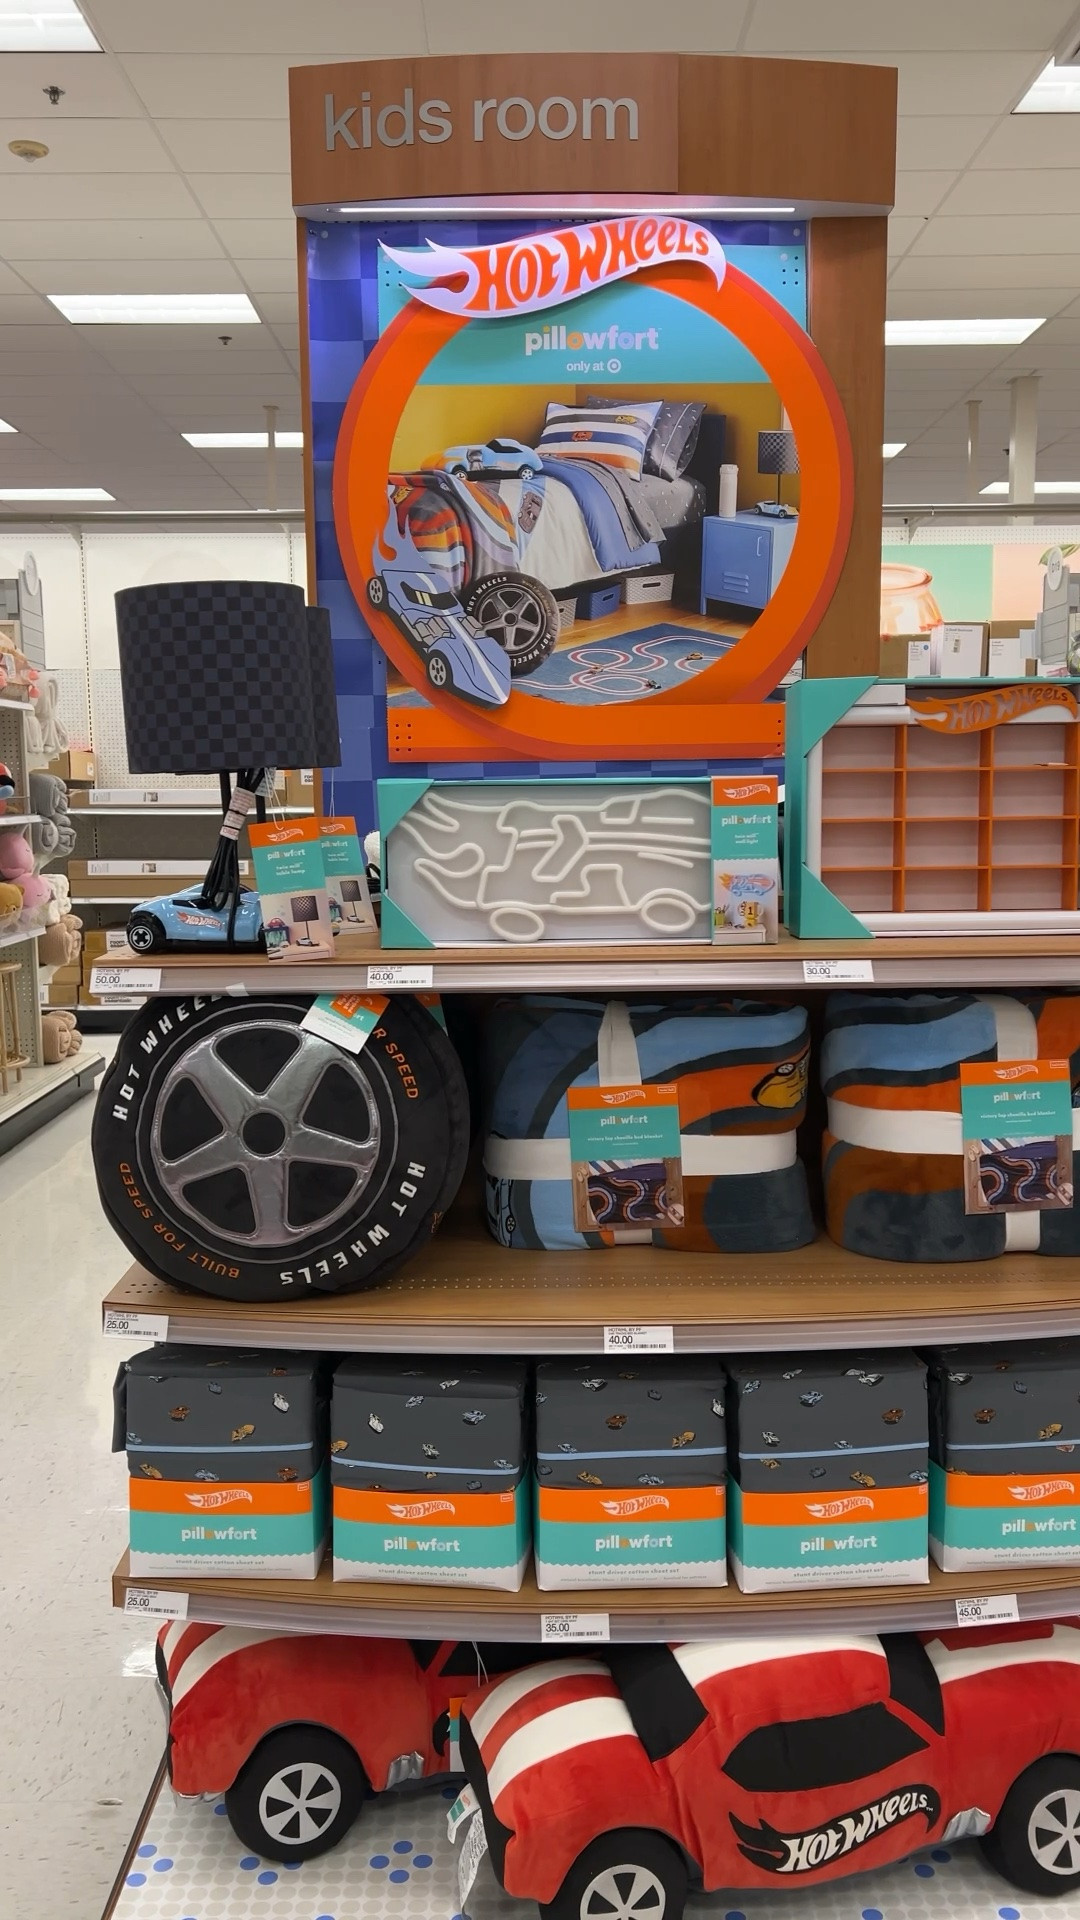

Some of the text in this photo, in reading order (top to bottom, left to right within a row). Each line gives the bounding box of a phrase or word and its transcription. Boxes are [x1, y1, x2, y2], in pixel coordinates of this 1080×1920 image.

[324, 87, 639, 152] kids room
[525, 325, 659, 356] pillowfort
[566, 360, 604, 373] only at
[467, 577, 507, 611] HOT WHEELS
[513, 650, 540, 667] WHEEL
[721, 814, 772, 827] pillowfort
[267, 849, 306, 861] pillowfort
[95, 975, 120, 984] 50.00
[112, 1063, 140, 1121] HOT
[139, 995, 222, 1054] WHEE
[385, 1042, 419, 1098] SPEED
[993, 1091, 1041, 1104] pillowfort
[600, 1115, 648, 1127] pillowfort
[119, 1162, 240, 1278] BUILT FOR SPEED
[279, 1161, 426, 1285] HOT WHEELS
[106, 1320, 129, 1329] 25.00
[608, 1335, 633, 1344] 40.00
[201, 1490, 249, 1507] HOT WHEELS
[617, 1495, 666, 1515] HOT WHEELS
[822, 1497, 871, 1517] HOT WHEELS
[403, 1501, 452, 1518] HOT WHEELS
[181, 1526, 257, 1542] pillowfort
[1002, 1517, 1077, 1536] pillowfort
[384, 1536, 460, 1552] pillowfort
[595, 1534, 673, 1551] pillowfort
[800, 1535, 878, 1554] pillowfort
[127, 1596, 150, 1606] 25.00
[959, 1607, 982, 1617] 45.00
[545, 1623, 570, 1632] 35.00
[775, 1828, 843, 1872] HOT
[837, 1792, 928, 1855] WHEELS
